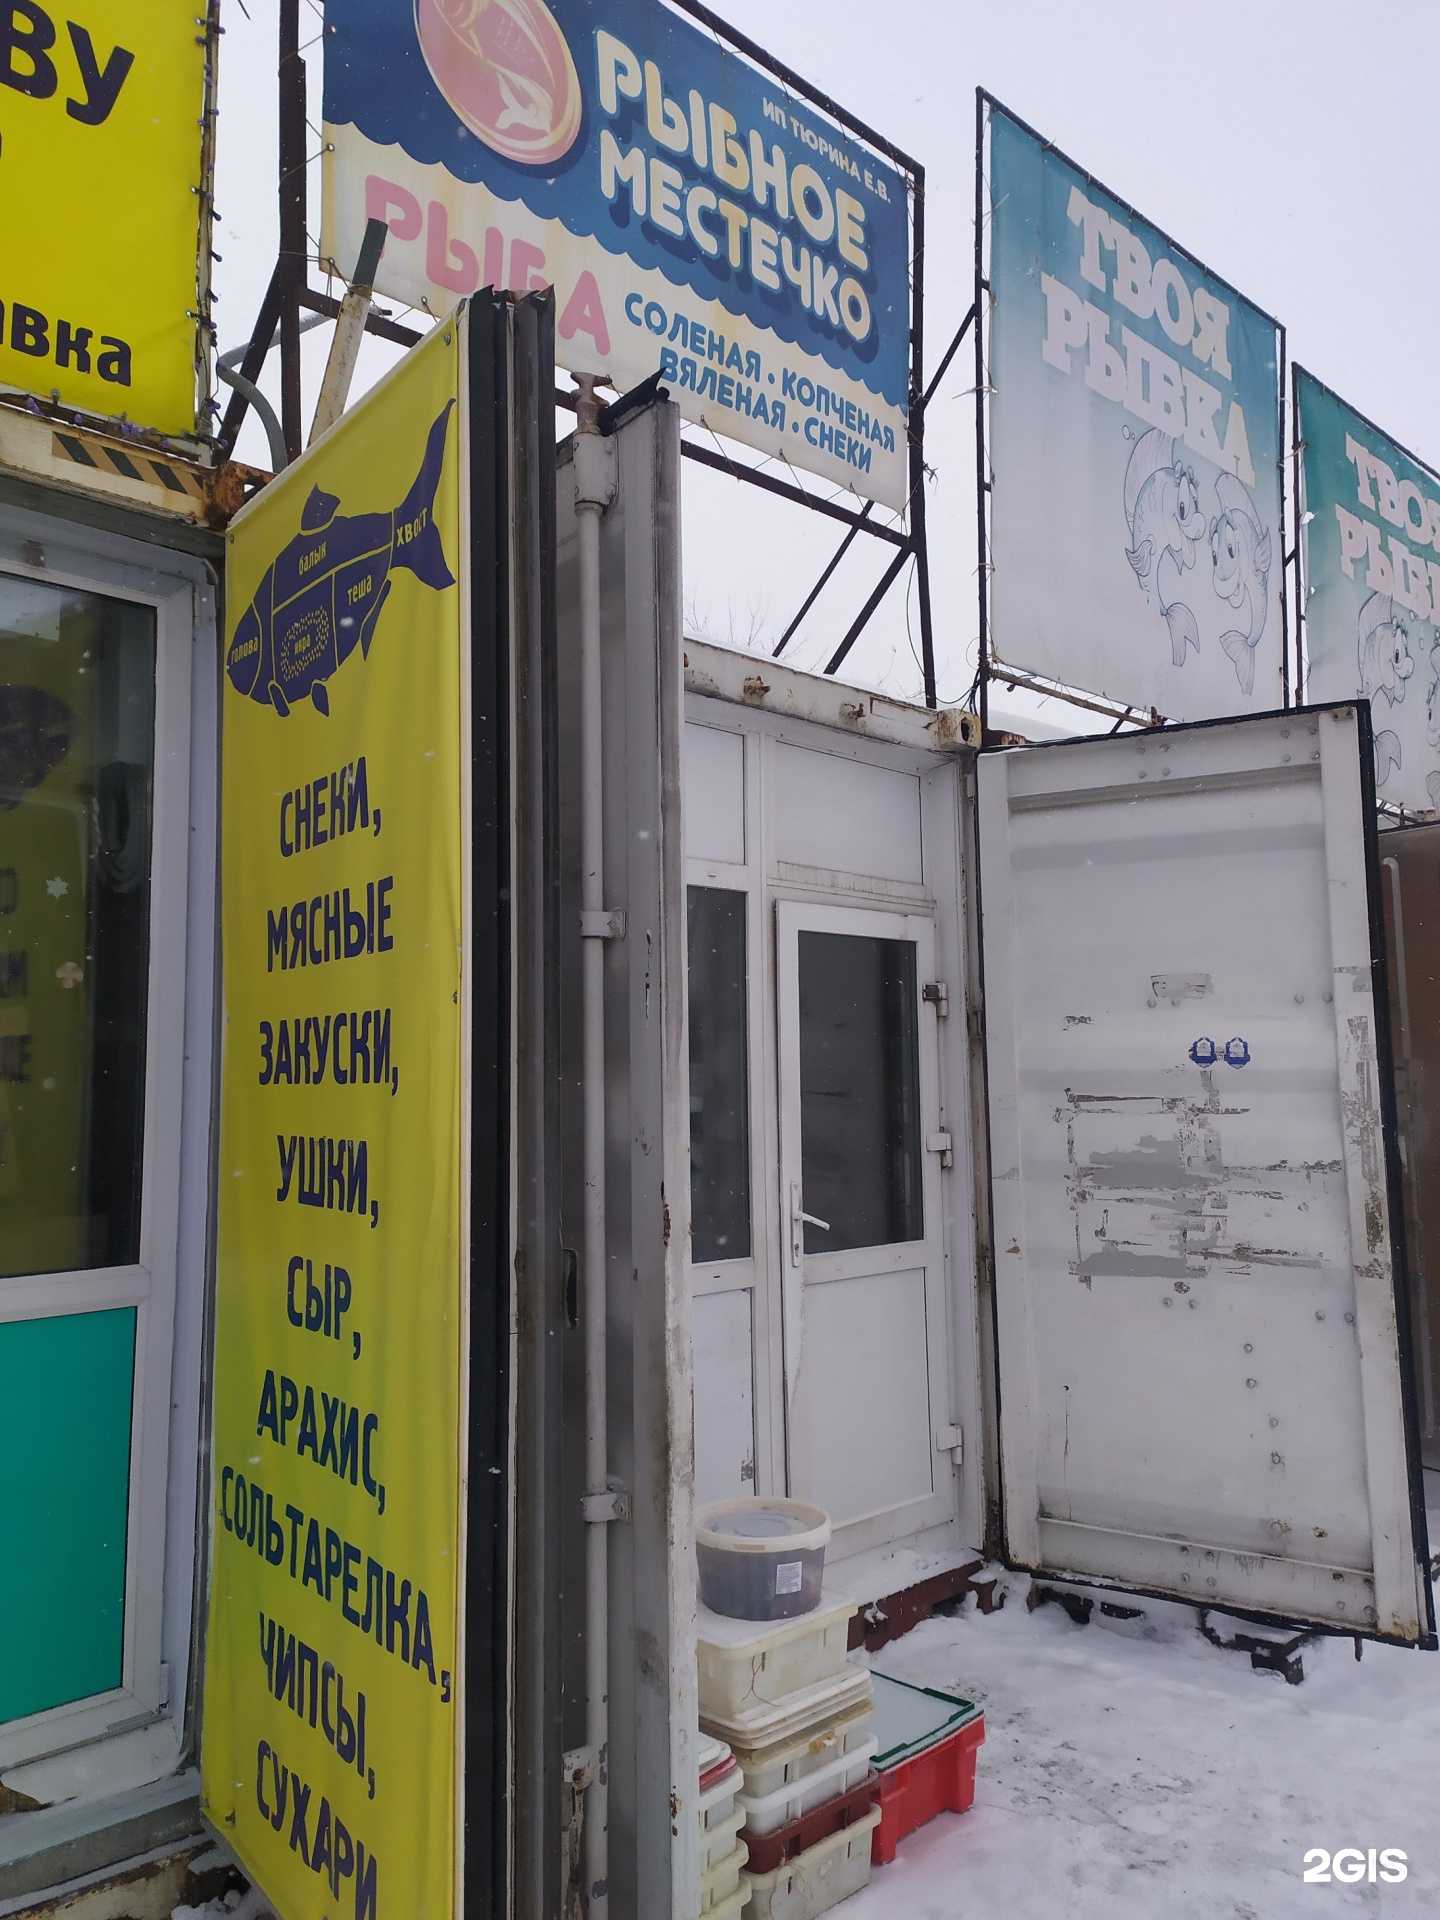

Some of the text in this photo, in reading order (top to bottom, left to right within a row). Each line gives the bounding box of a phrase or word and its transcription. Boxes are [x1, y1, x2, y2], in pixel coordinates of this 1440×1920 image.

[597, 29, 869, 273] РЫБНОЕ
[763, 97, 892, 204] ИП ТЮРИНА Е.В.
[601, 129, 871, 341] МЕСТЕЧКО
[1066, 185, 1232, 381] ТВОЯ
[0, 300, 132, 387] вка
[624, 292, 896, 453] СОЛЕНАЯ КОПЧЕНАЯ
[1041, 271, 1256, 488] РЫБКА
[660, 347, 872, 474] ВЯЛЕНАЯ СНЕКИ
[298, 542, 327, 576] балык
[347, 574, 373, 606] теша
[280, 756, 381, 858] СНЕКИ,
[267, 876, 394, 972] МЯСНЫЕ
[259, 1008, 398, 1096] ЗАКУСКИ,
[276, 1135, 379, 1229] УШКИ,
[287, 1256, 361, 1360] СЫР,
[256, 1369, 386, 1516] АРАХИС,
[259, 1611, 376, 1800] ЧИПСЫ,
[256, 1739, 377, 1920] СУХАРИ
